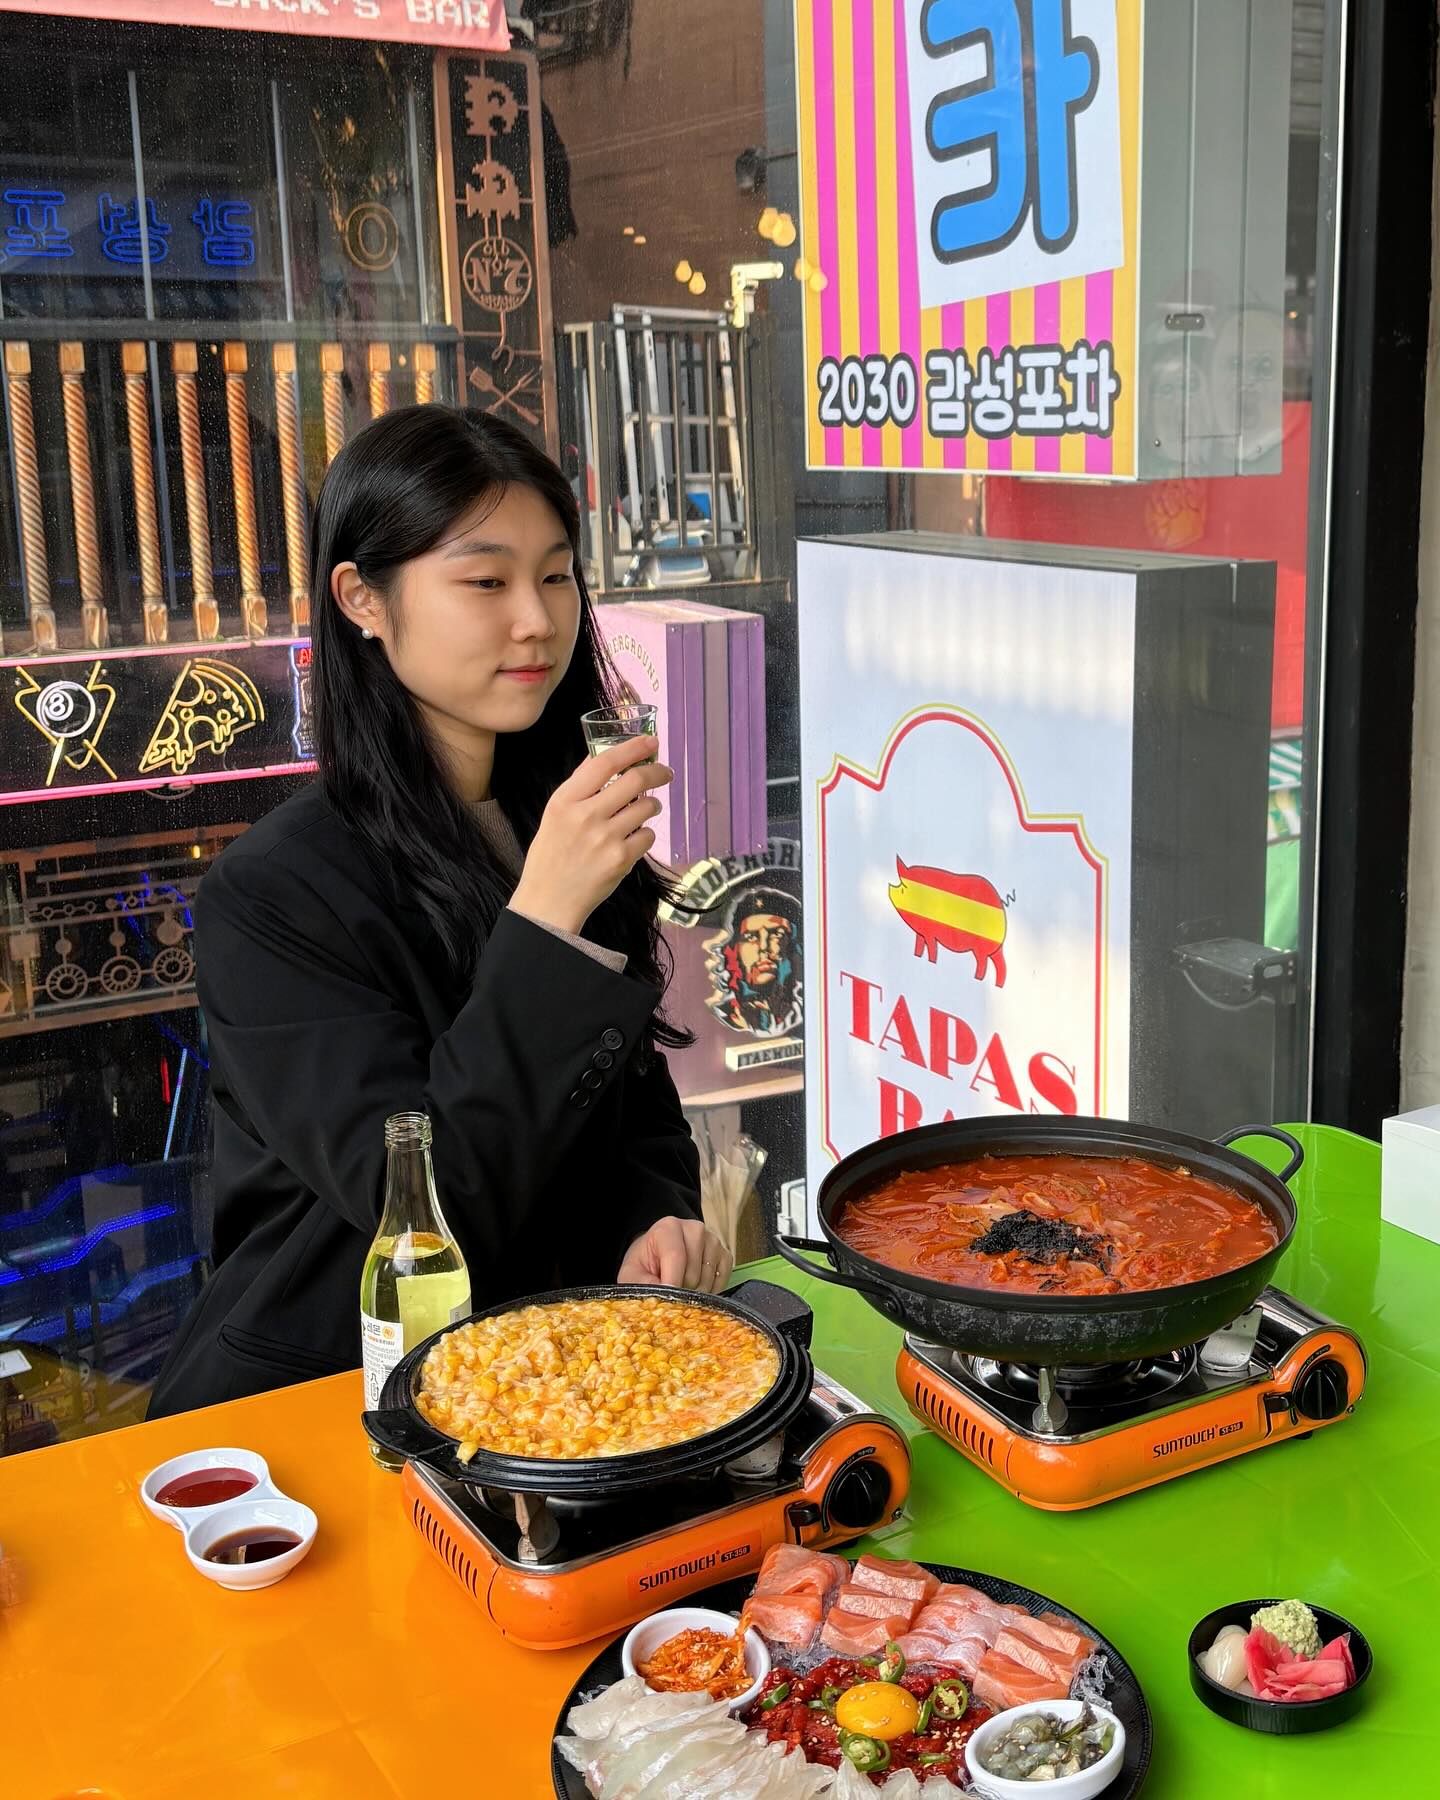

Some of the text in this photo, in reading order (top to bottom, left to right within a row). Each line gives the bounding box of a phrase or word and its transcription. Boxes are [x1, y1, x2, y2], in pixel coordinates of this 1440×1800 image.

[406, 0, 490, 27] BAR
[818, 345, 1119, 434] 2030 감성포차
[48, 692, 66, 717] 8
[840, 970, 1078, 1116] TAPAS
